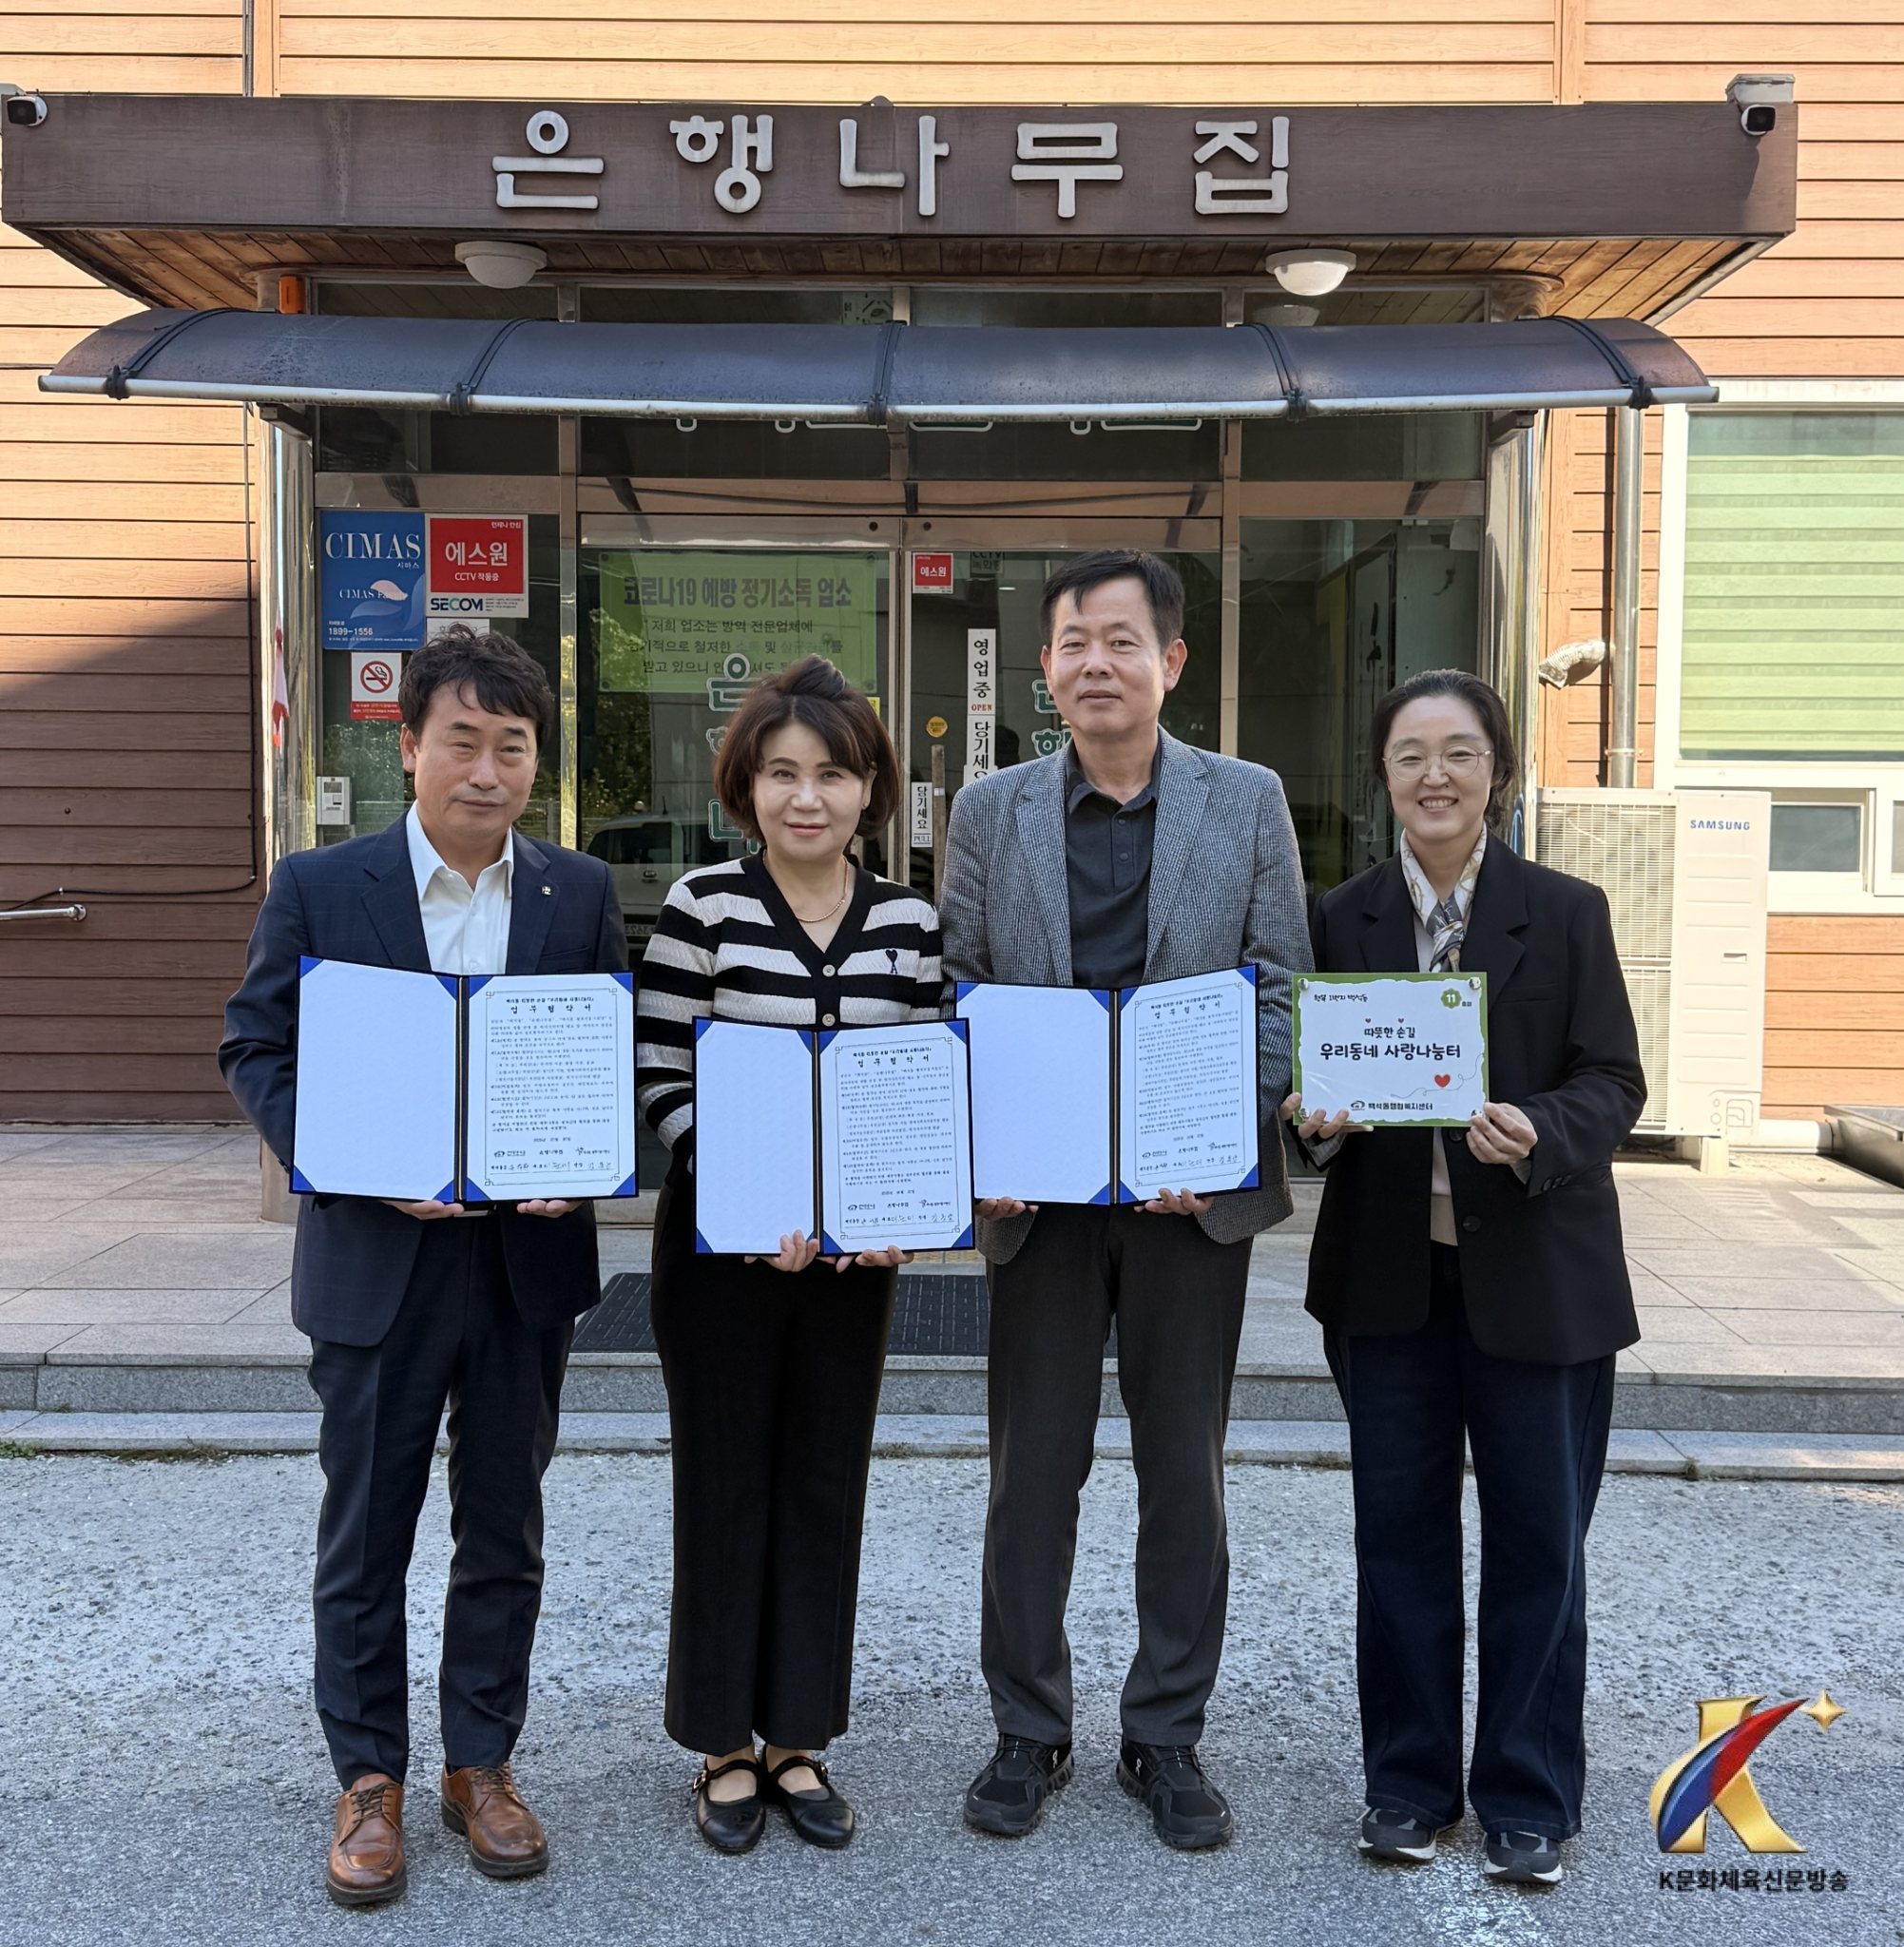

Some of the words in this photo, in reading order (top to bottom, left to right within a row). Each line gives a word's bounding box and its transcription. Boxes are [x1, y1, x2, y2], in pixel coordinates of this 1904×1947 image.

[492, 110, 1291, 218] 은행나무집
[325, 532, 421, 560] CIMAS
[445, 542, 508, 567] 에스원
[454, 572, 477, 581] CCTV
[920, 567, 947, 577] 에스원
[339, 588, 375, 599] CIMAS
[624, 576, 698, 607] 코로나19
[702, 577, 737, 608] 예방
[741, 577, 812, 608] 정기소독
[817, 577, 853, 607] 업소
[431, 598, 483, 611] SECOM
[328, 627, 374, 636] 1899-1556
[651, 619, 676, 633] 저희
[681, 619, 718, 633] 업소는
[722, 620, 746, 634] 방역
[751, 620, 813, 634] 전문업체에
[764, 640, 777, 654] 및
[672, 661, 709, 674] 있으니
[973, 639, 991, 699] 영업중
[916, 785, 928, 829] 당기세요
[1690, 819, 1750, 831] SAMSUNG
[1446, 993, 1456, 1003] 11
[1364, 1027, 1394, 1039] 따뜻한
[1396, 1027, 1416, 1039] 손길
[1319, 1043, 1378, 1060] 우리동네
[1384, 1043, 1461, 1061] 사랑나눔터
